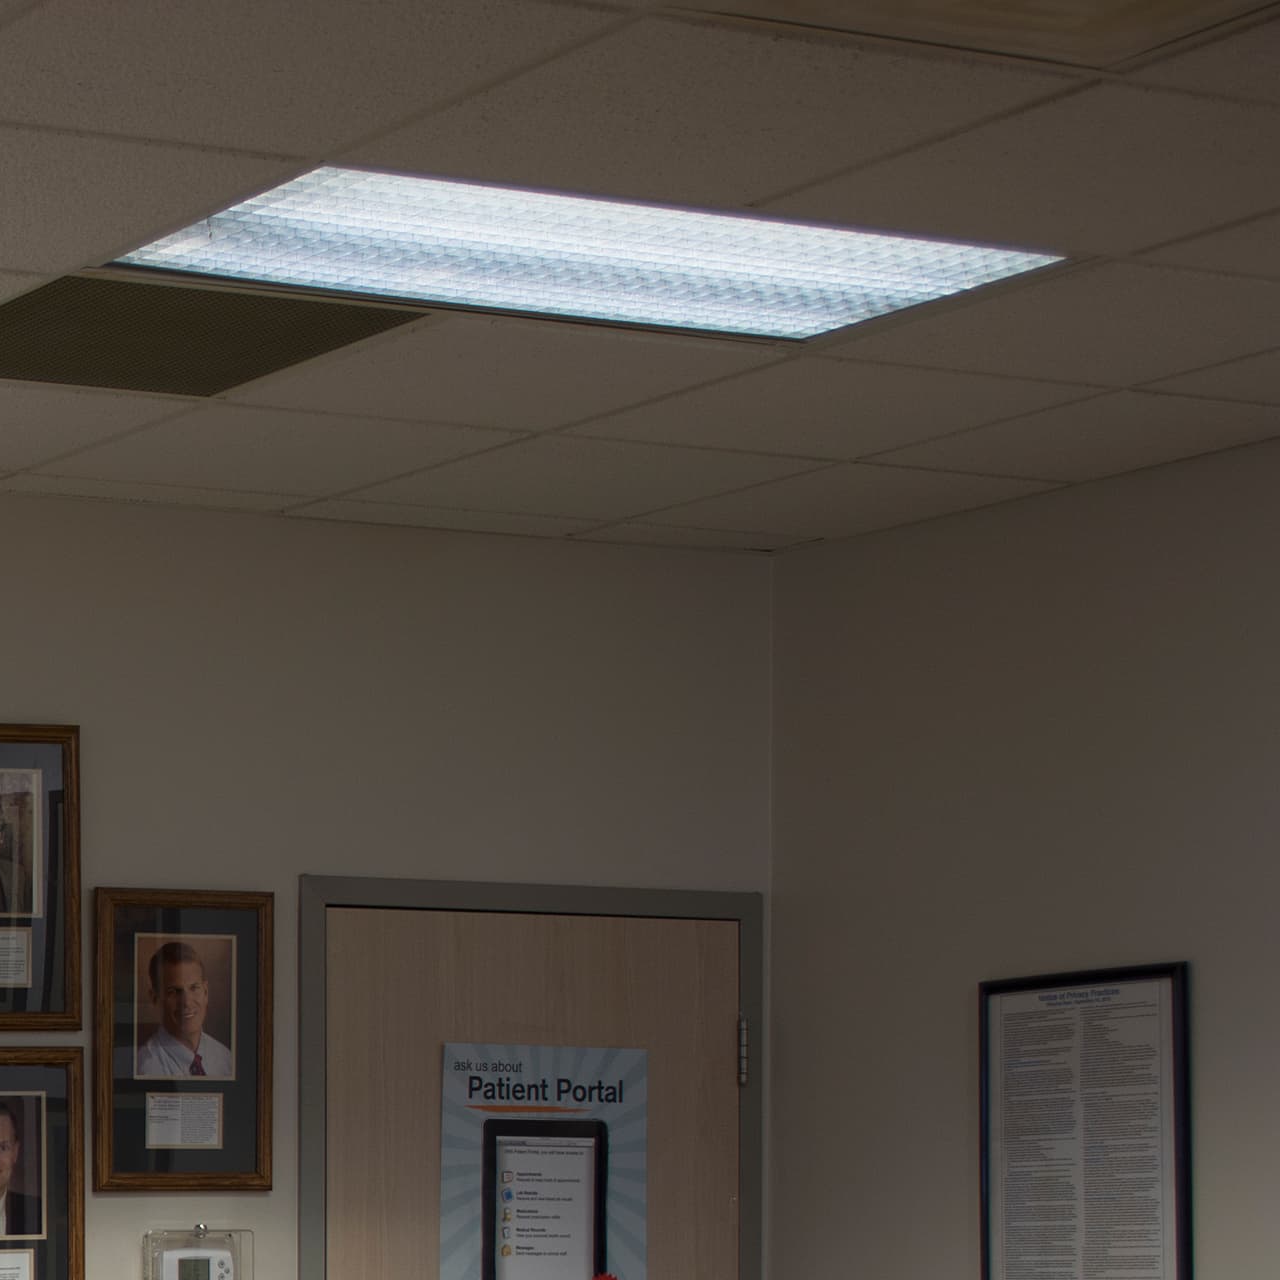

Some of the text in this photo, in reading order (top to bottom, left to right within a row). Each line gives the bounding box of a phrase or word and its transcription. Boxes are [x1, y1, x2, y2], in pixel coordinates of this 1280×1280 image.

[453, 1058, 523, 1073] ask us about
[467, 1075, 624, 1104] Patient Portal
